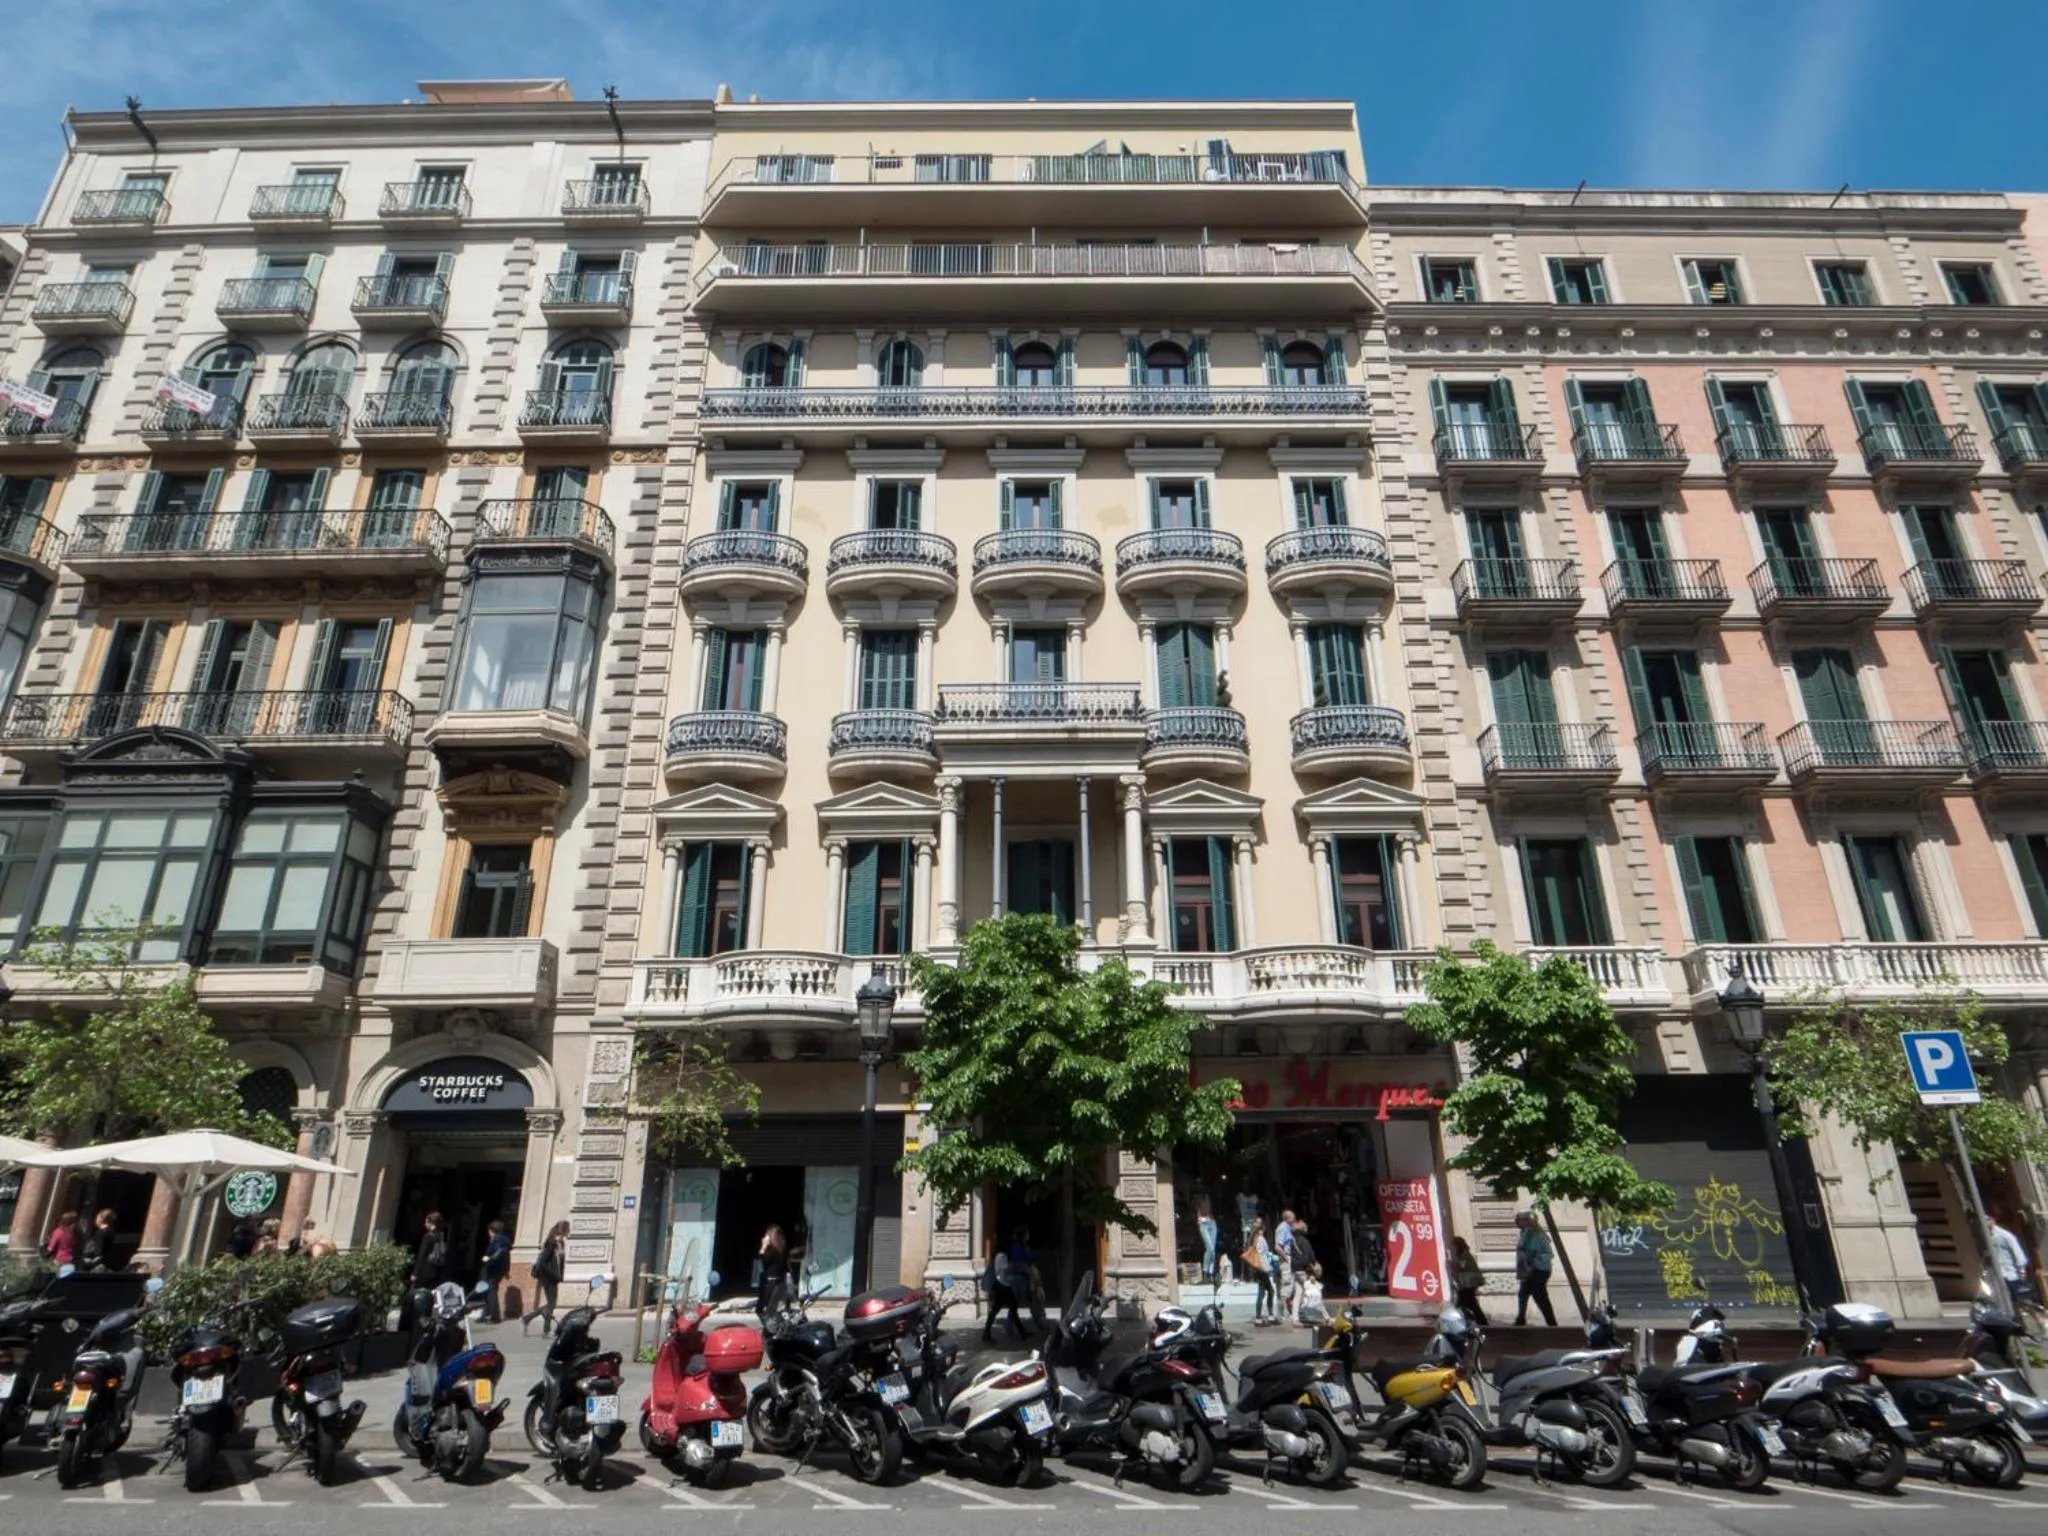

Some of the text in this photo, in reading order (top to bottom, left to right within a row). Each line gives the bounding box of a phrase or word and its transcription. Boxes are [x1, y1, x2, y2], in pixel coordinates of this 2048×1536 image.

[1914, 1038, 1954, 1085] P
[419, 1075, 504, 1087] STARBUCKS
[432, 1087, 487, 1099] COFFEE
[1379, 1183, 1428, 1198] OFERTA
[1388, 1220, 1418, 1291] 2
